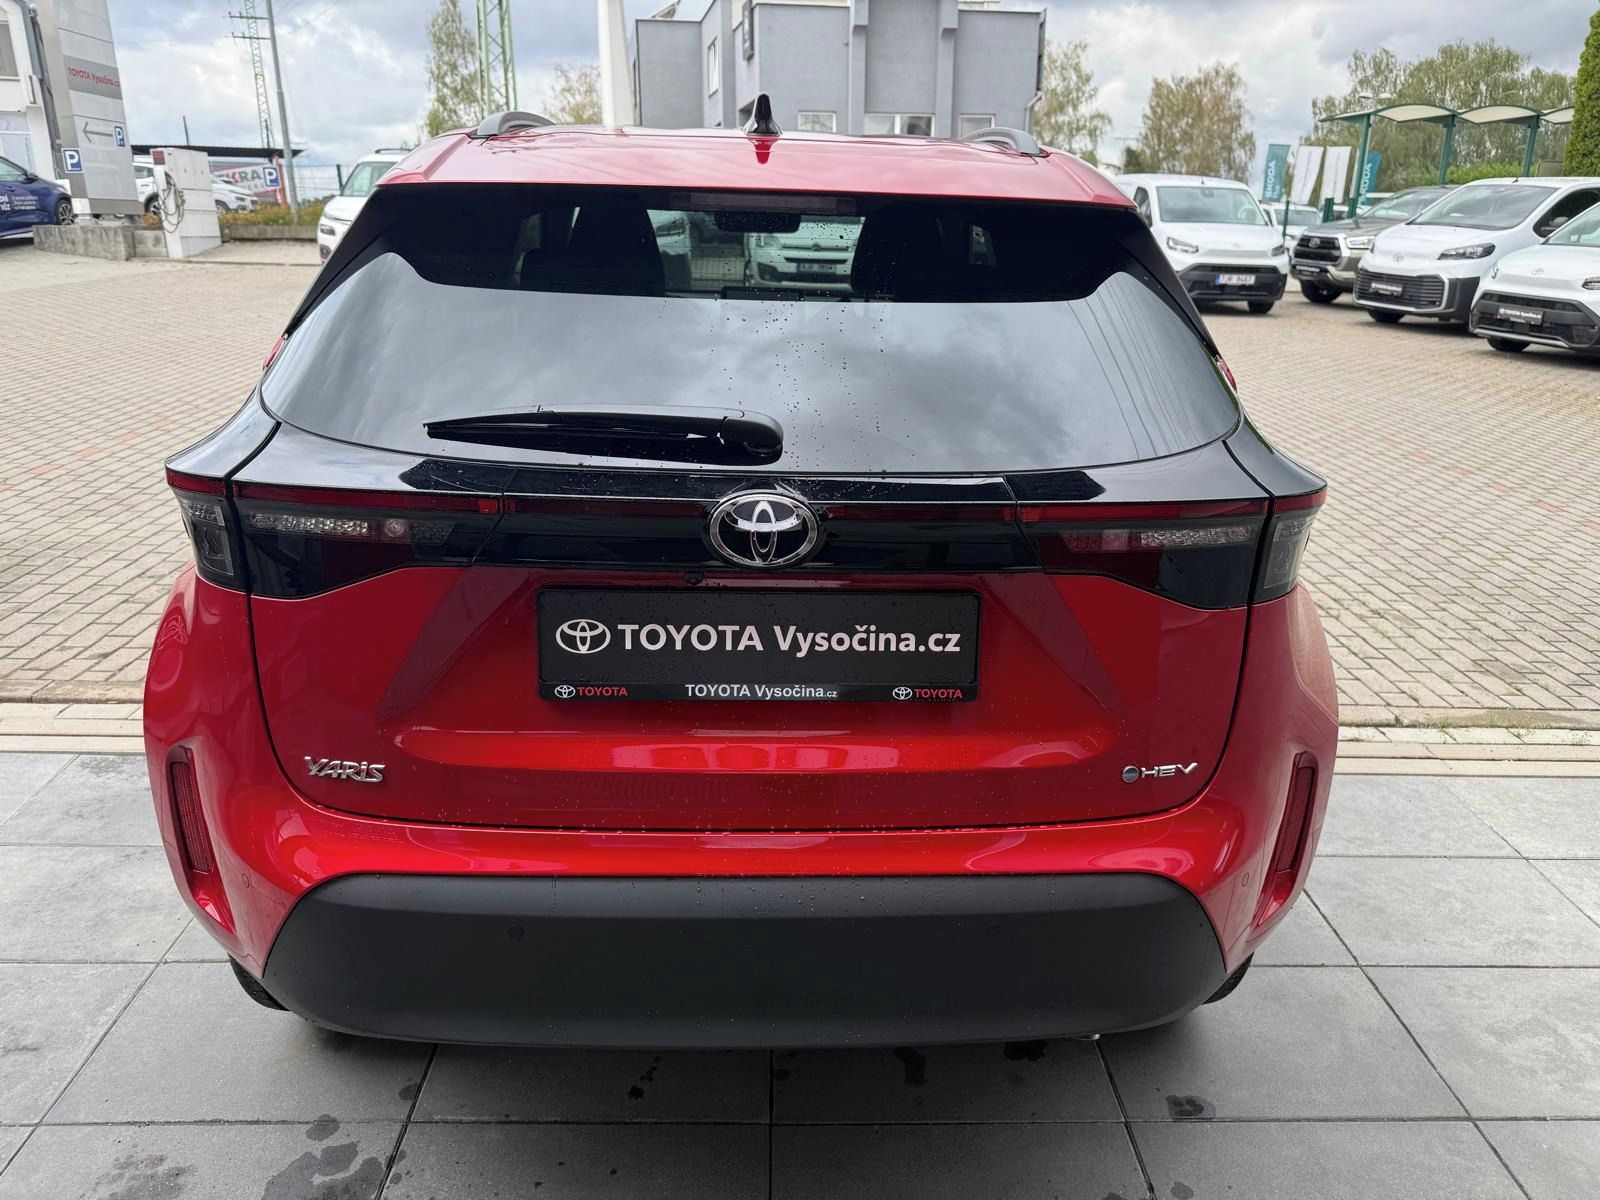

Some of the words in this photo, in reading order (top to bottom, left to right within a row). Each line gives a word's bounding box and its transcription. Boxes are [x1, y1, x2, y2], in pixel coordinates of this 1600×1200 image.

[68, 67, 91, 80] TOYOTA
[115, 127, 123, 145] P
[64, 150, 79, 170] P
[265, 169, 277, 185] P
[617, 624, 764, 651] TOYOTA
[773, 625, 961, 658] Vysočina.cz
[578, 687, 628, 696] TOYOTA
[685, 684, 750, 697] TOYOTA
[754, 684, 838, 699] Vysočina.cz
[914, 688, 963, 699] TOYOTA
[1141, 763, 1198, 778] HEV
